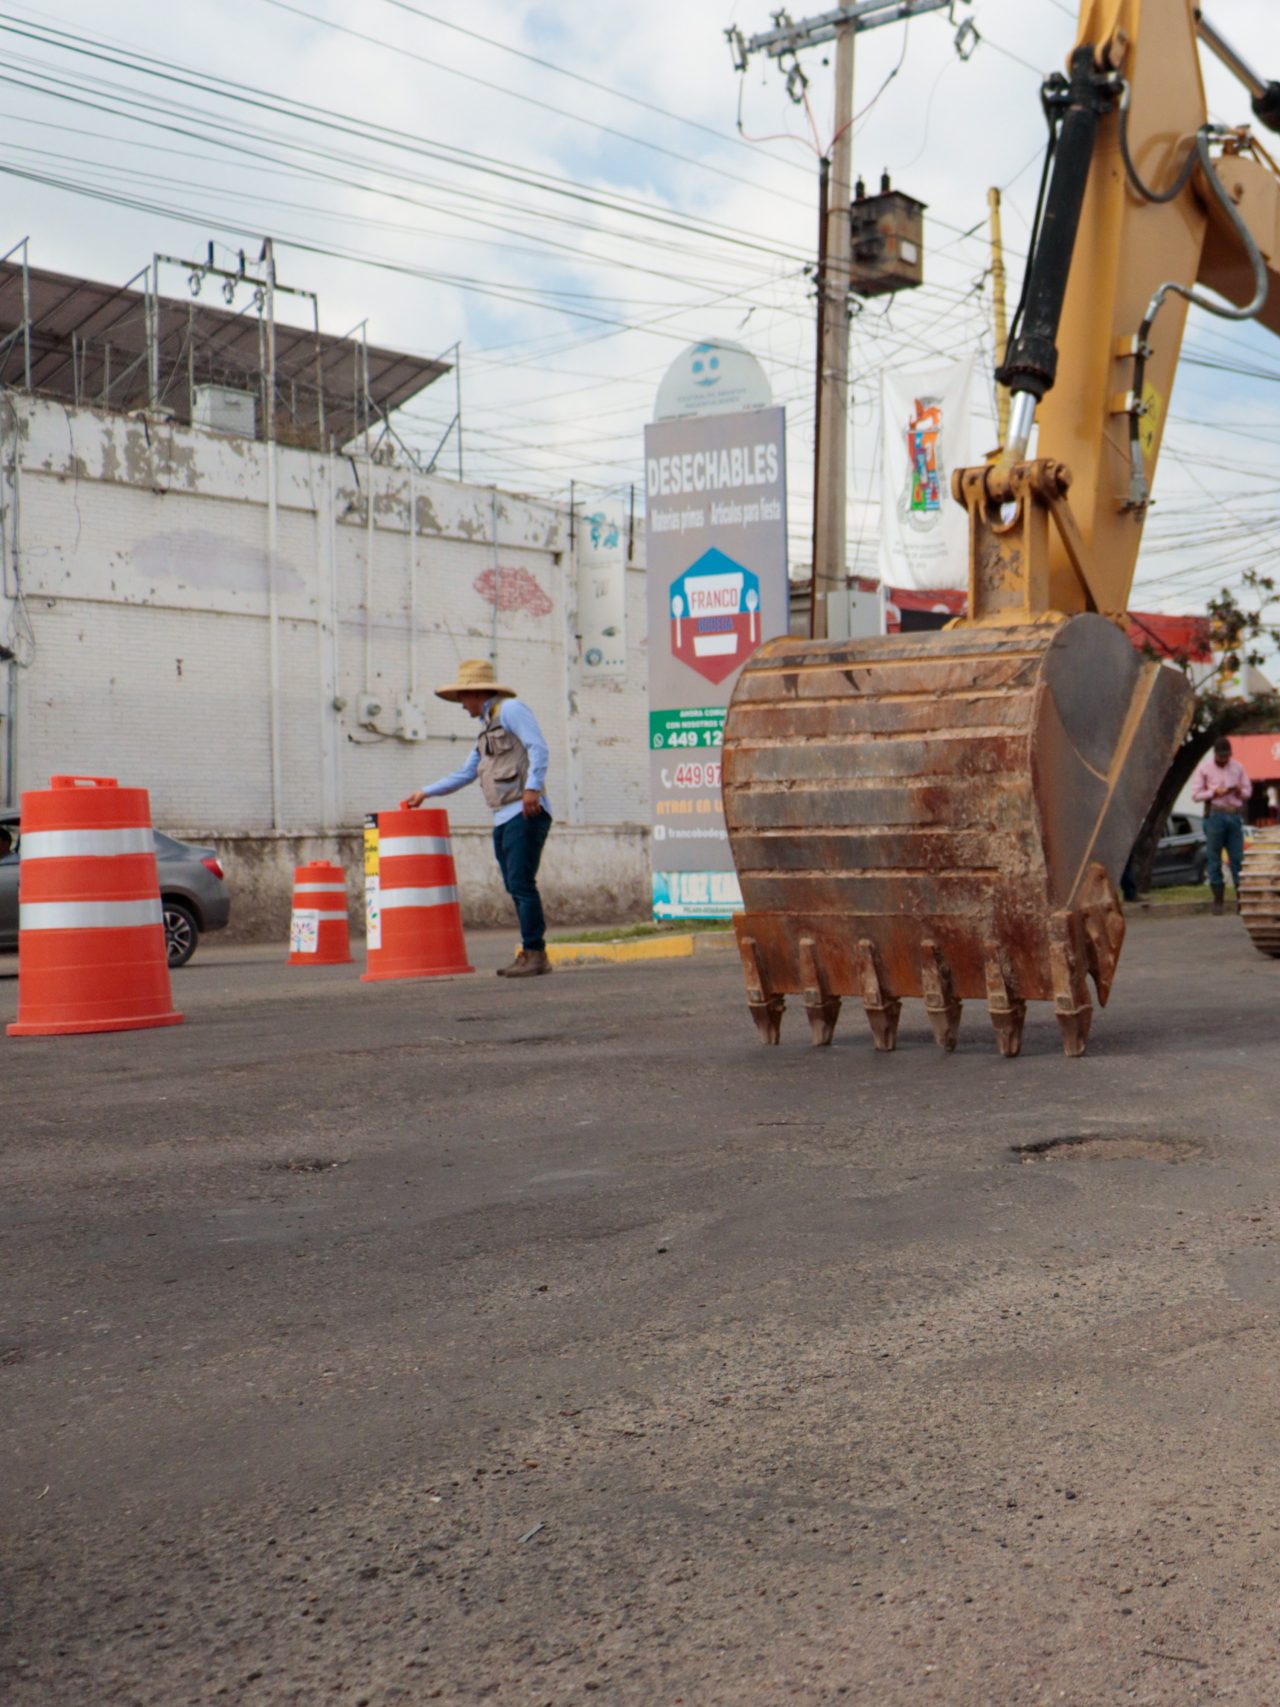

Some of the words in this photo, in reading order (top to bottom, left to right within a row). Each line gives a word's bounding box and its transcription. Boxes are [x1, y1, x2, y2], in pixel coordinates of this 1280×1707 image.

[648, 443, 779, 497] DESECHABLES
[691, 588, 738, 610] FRANCO
[668, 731, 698, 747] 449
[675, 764, 702, 786] 449
